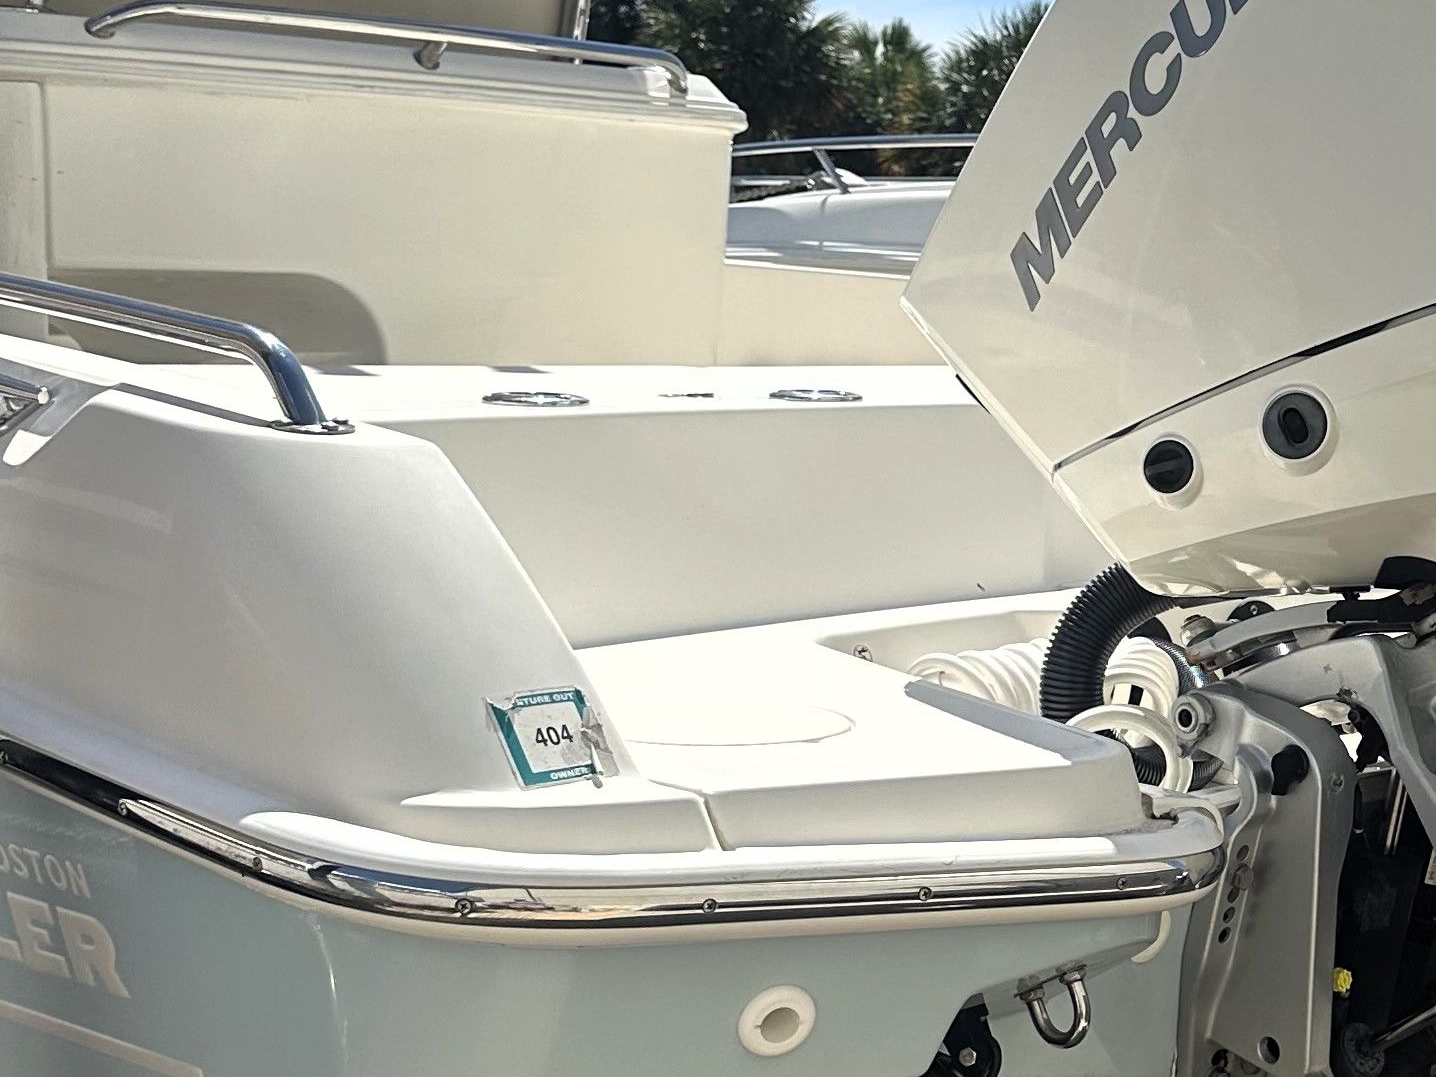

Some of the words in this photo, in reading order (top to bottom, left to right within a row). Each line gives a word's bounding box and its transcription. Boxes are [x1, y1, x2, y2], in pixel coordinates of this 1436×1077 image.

[552, 691, 575, 701] OUT
[535, 723, 574, 747] 404
[550, 766, 589, 780] OWNER
